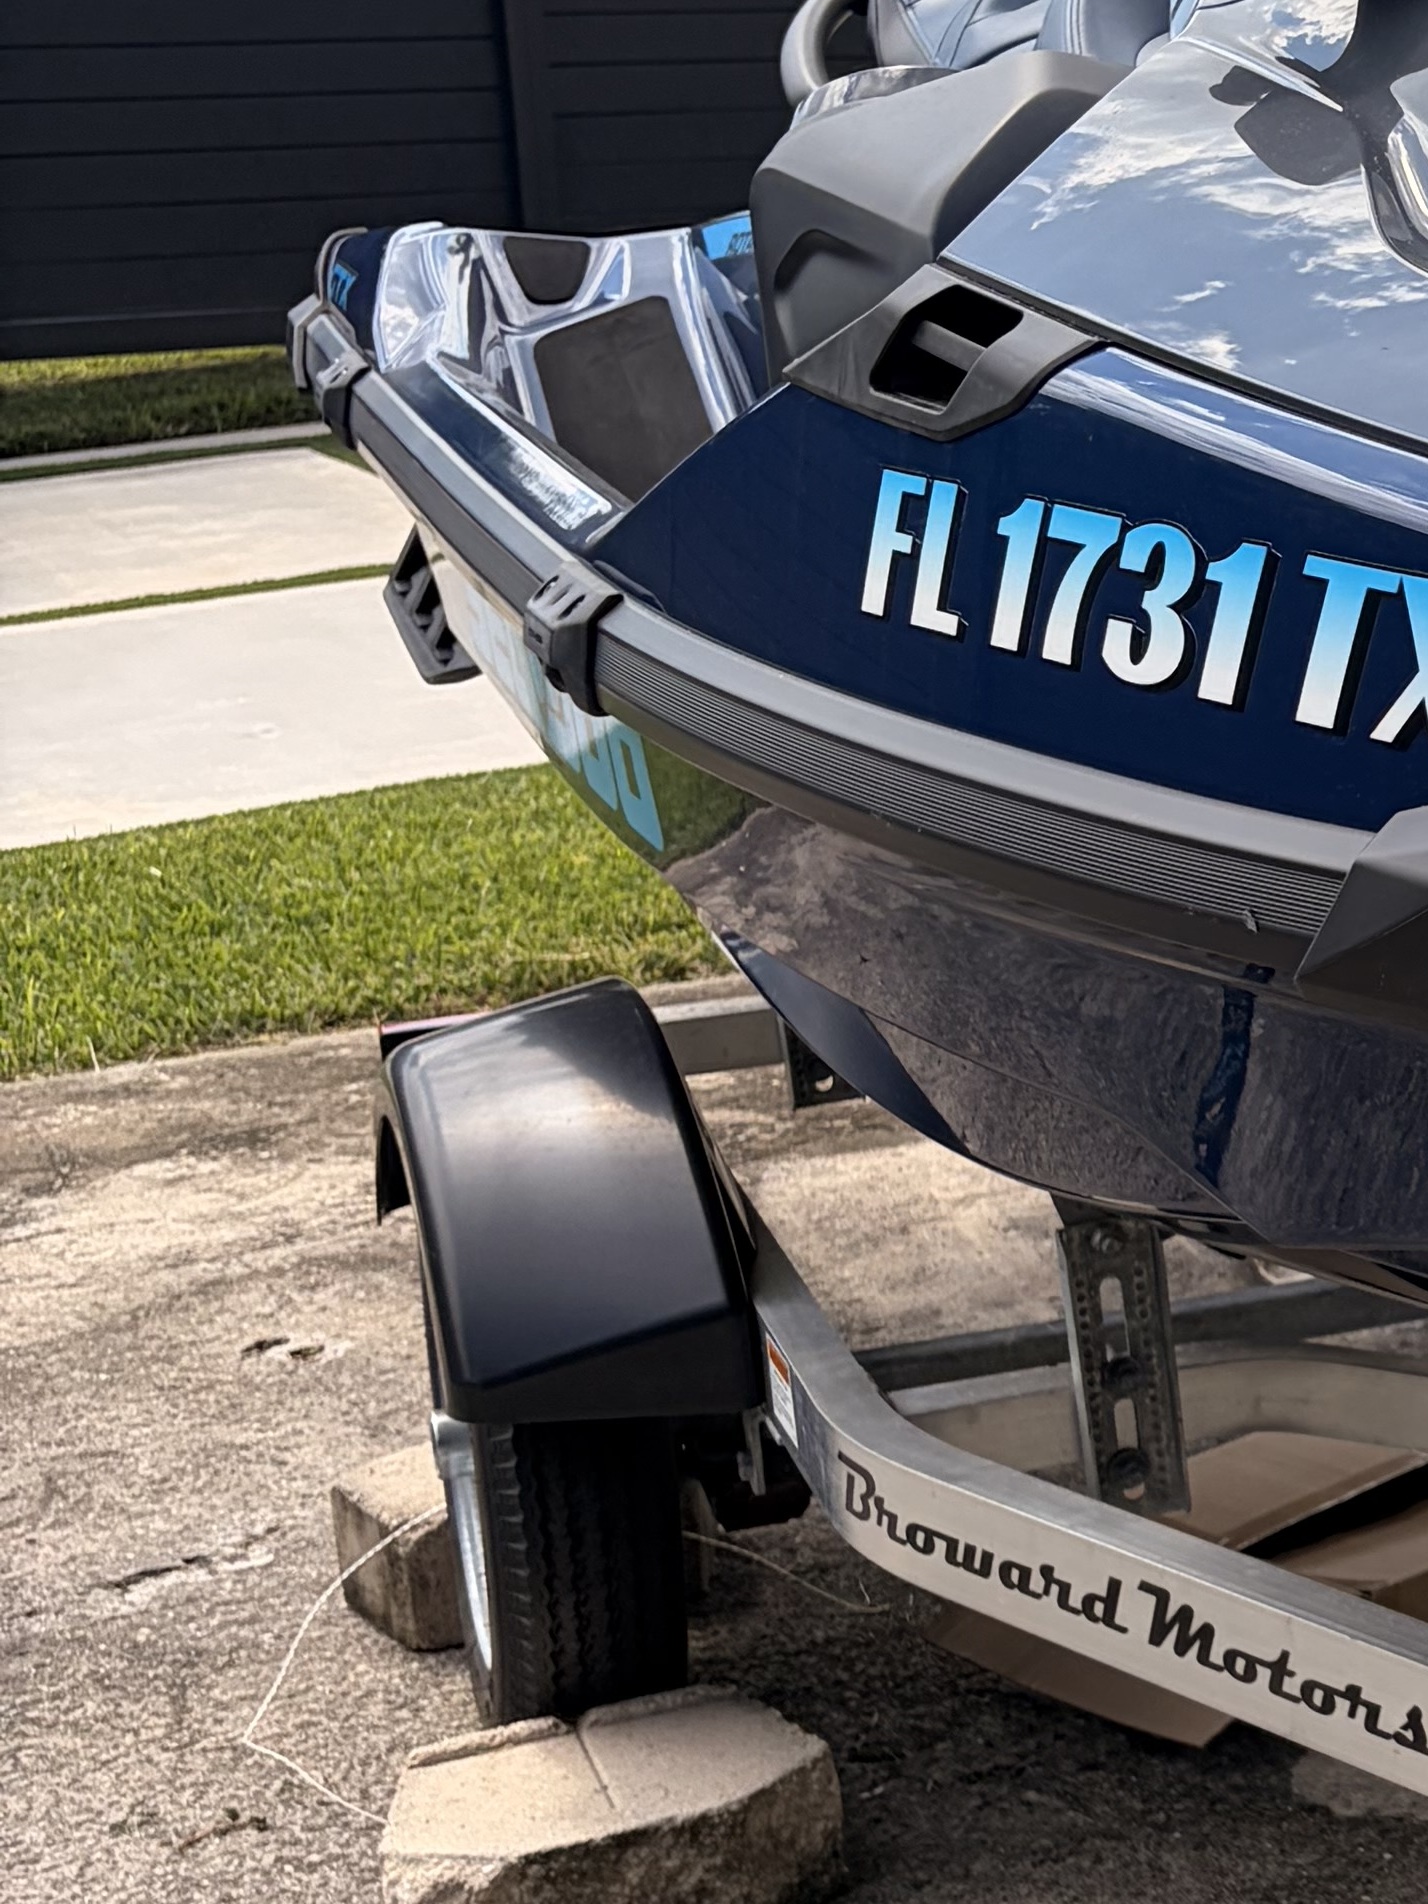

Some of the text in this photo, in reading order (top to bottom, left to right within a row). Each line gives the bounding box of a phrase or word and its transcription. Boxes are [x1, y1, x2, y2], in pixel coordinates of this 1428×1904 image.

[861, 469, 967, 637] FL
[989, 496, 1281, 712] 1731
[838, 1451, 1128, 1634] Broward
